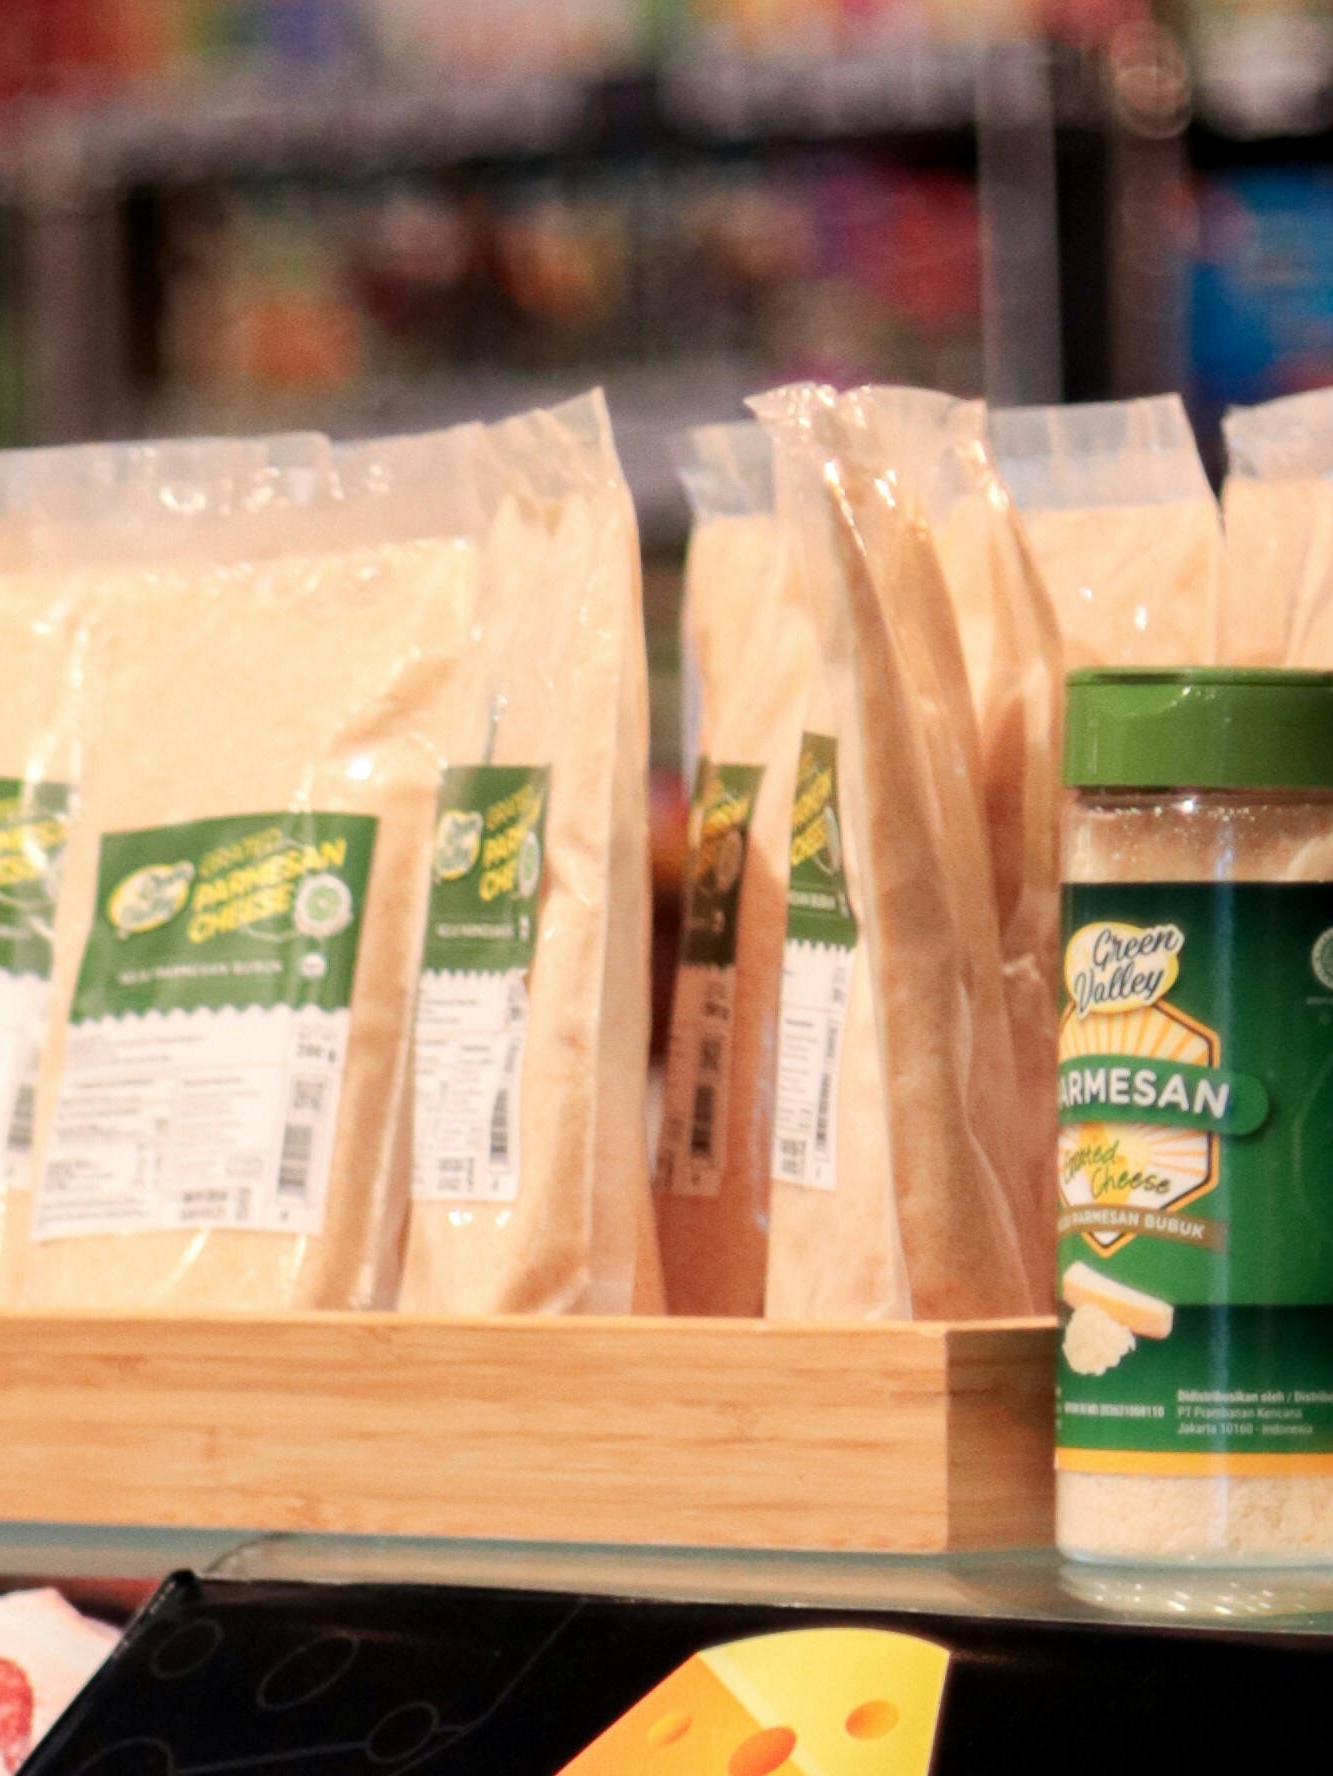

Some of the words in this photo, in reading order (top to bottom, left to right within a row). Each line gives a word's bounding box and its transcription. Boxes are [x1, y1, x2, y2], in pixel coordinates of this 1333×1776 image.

[1093, 928, 1180, 968] Green
[1074, 964, 1165, 1014] Valley
[1090, 1167, 1171, 1198] Cheese
[1073, 1209, 1140, 1228] PARMESAN
[1144, 1213, 1206, 1240] BUBUK
